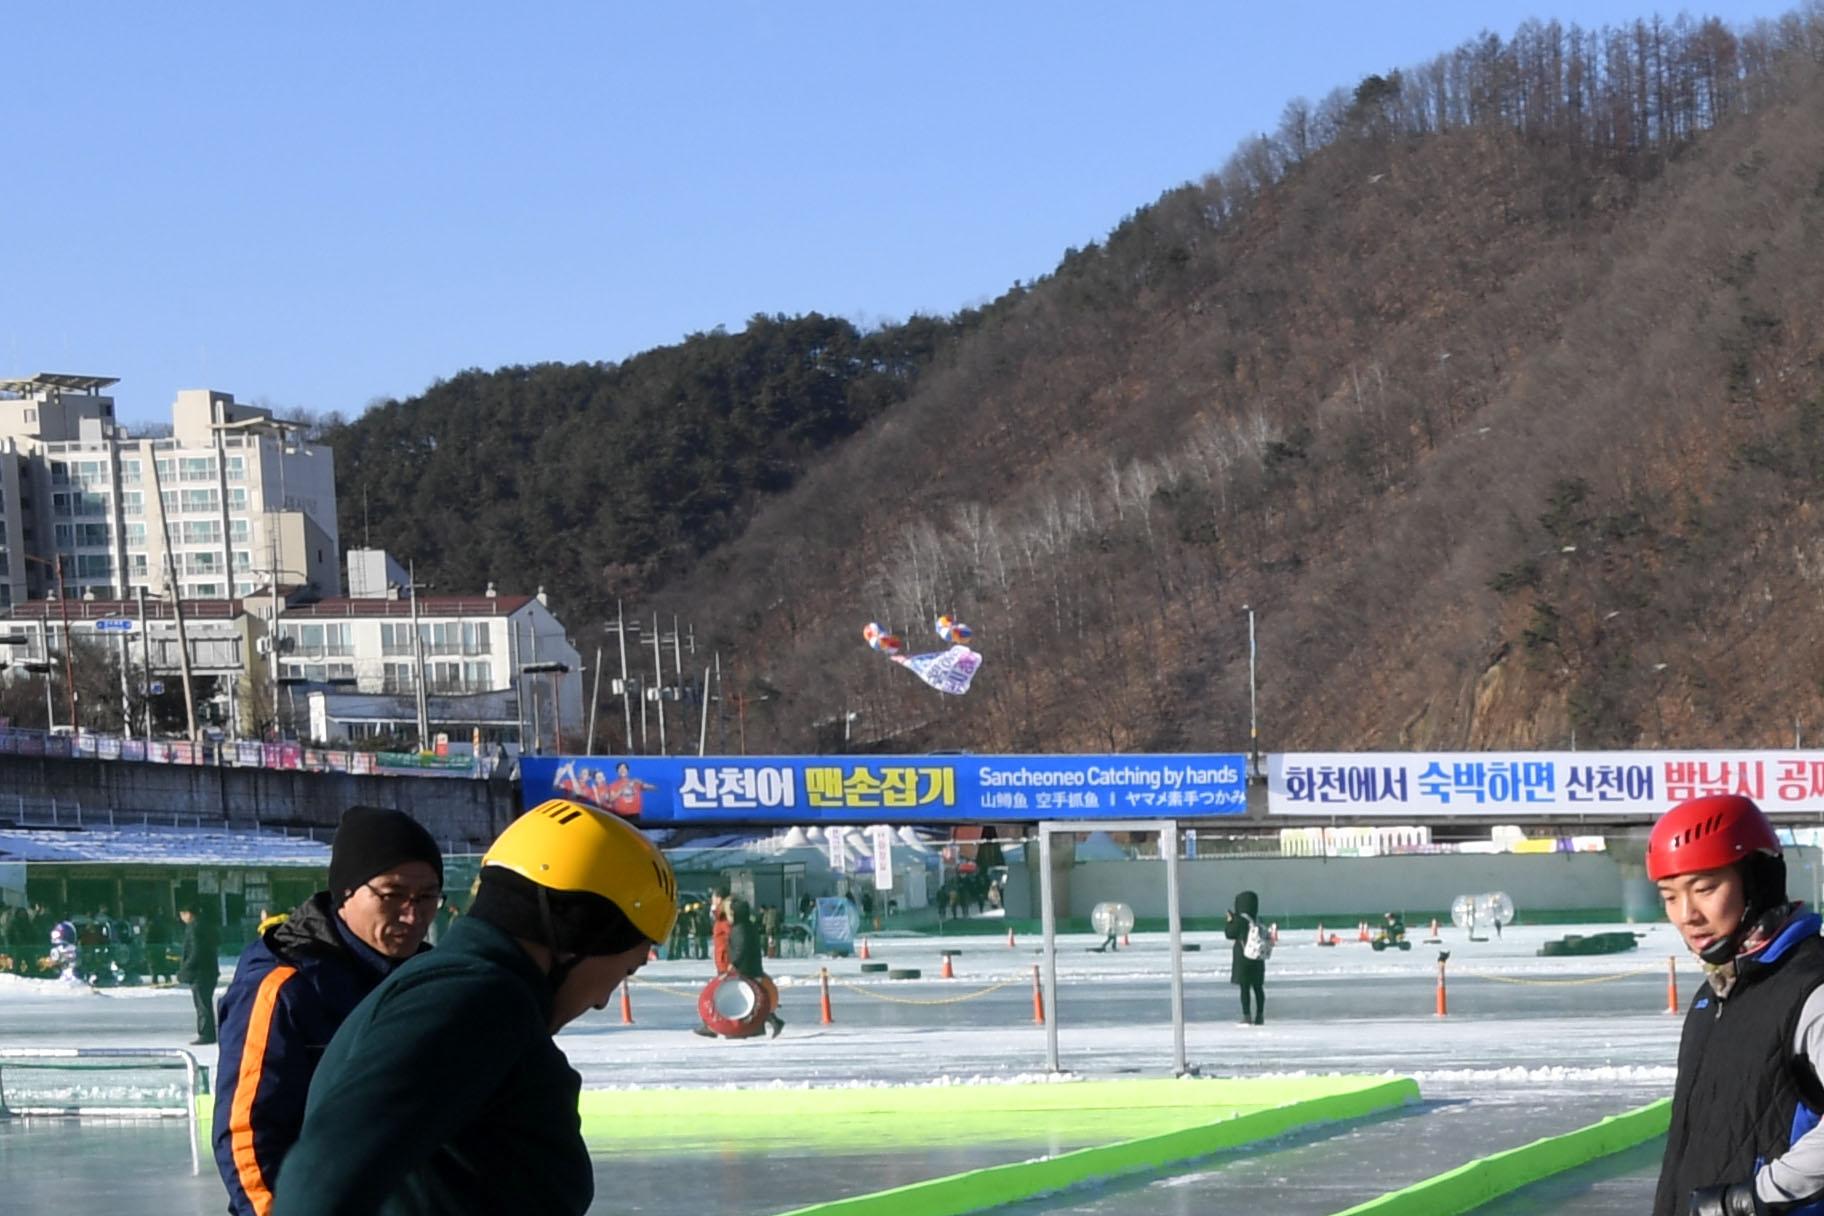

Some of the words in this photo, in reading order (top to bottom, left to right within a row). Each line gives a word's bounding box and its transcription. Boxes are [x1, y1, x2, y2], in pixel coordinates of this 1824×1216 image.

[680, 767, 794, 807] 산천어
[805, 766, 954, 807] 맨손잡기
[979, 767, 1084, 786] Sancheoneo
[1087, 766, 1161, 789] Catching
[1164, 766, 1184, 789] by
[1187, 765, 1239, 785] hands
[1286, 766, 1409, 803] 화천에서
[1418, 761, 1556, 803] 숙박하면
[1565, 765, 1654, 802] 산천어
[1664, 760, 1765, 802] 밤낚시
